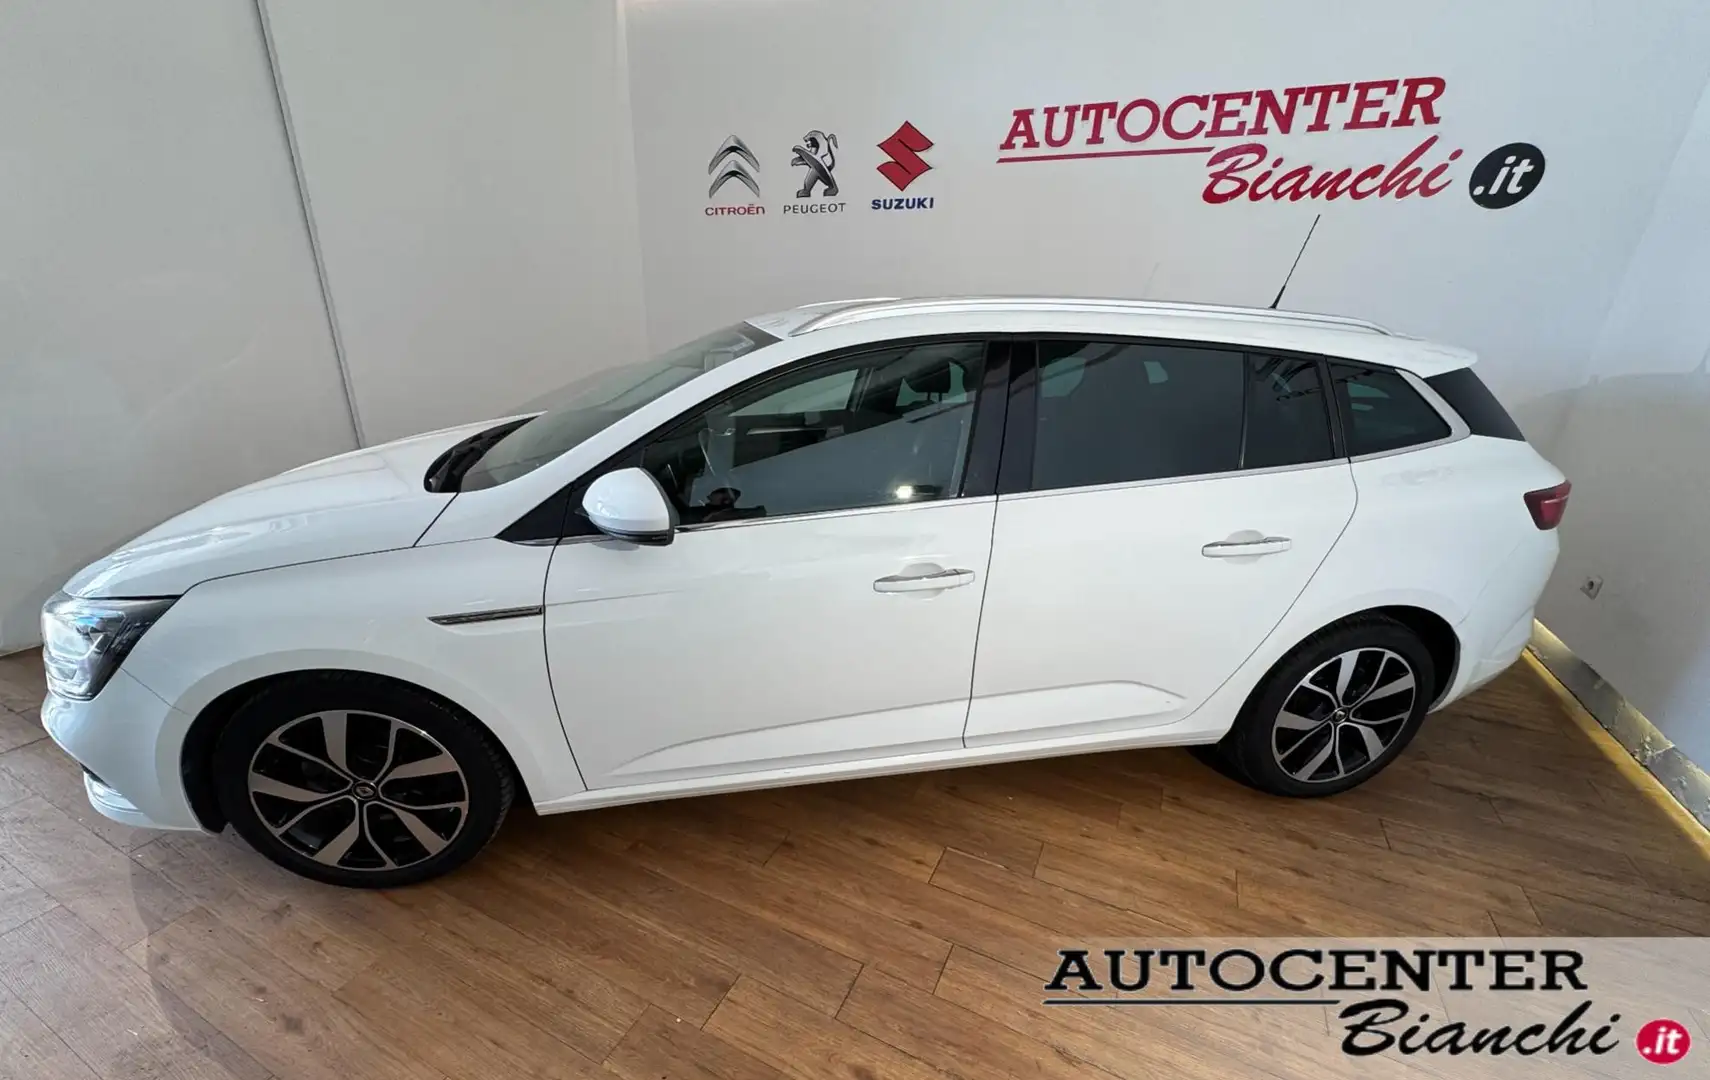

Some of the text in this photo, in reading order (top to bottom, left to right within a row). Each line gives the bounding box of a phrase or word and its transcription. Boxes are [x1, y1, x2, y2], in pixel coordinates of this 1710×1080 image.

[1000, 76, 1446, 150] AUTOCENTER
[1201, 135, 1534, 205] Bianchi .it
[783, 202, 846, 214] PEUGEOT
[871, 197, 934, 210] SUZUKI
